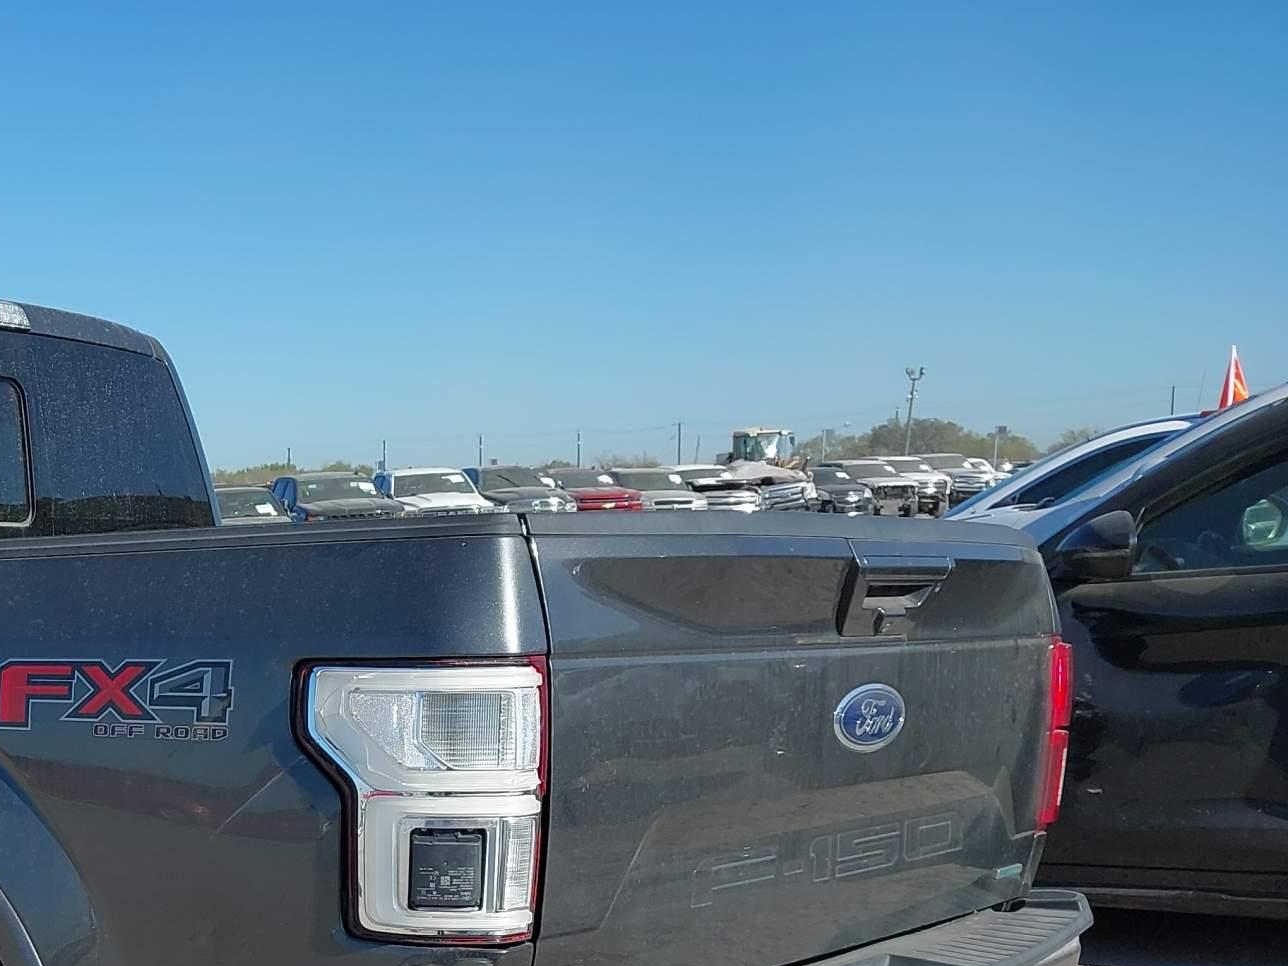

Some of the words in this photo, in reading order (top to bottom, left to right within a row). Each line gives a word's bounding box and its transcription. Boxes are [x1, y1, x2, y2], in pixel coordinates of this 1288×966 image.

[93, 723, 145, 738] OFF
[154, 725, 229, 741] ROAD
[690, 811, 963, 908] F-150
